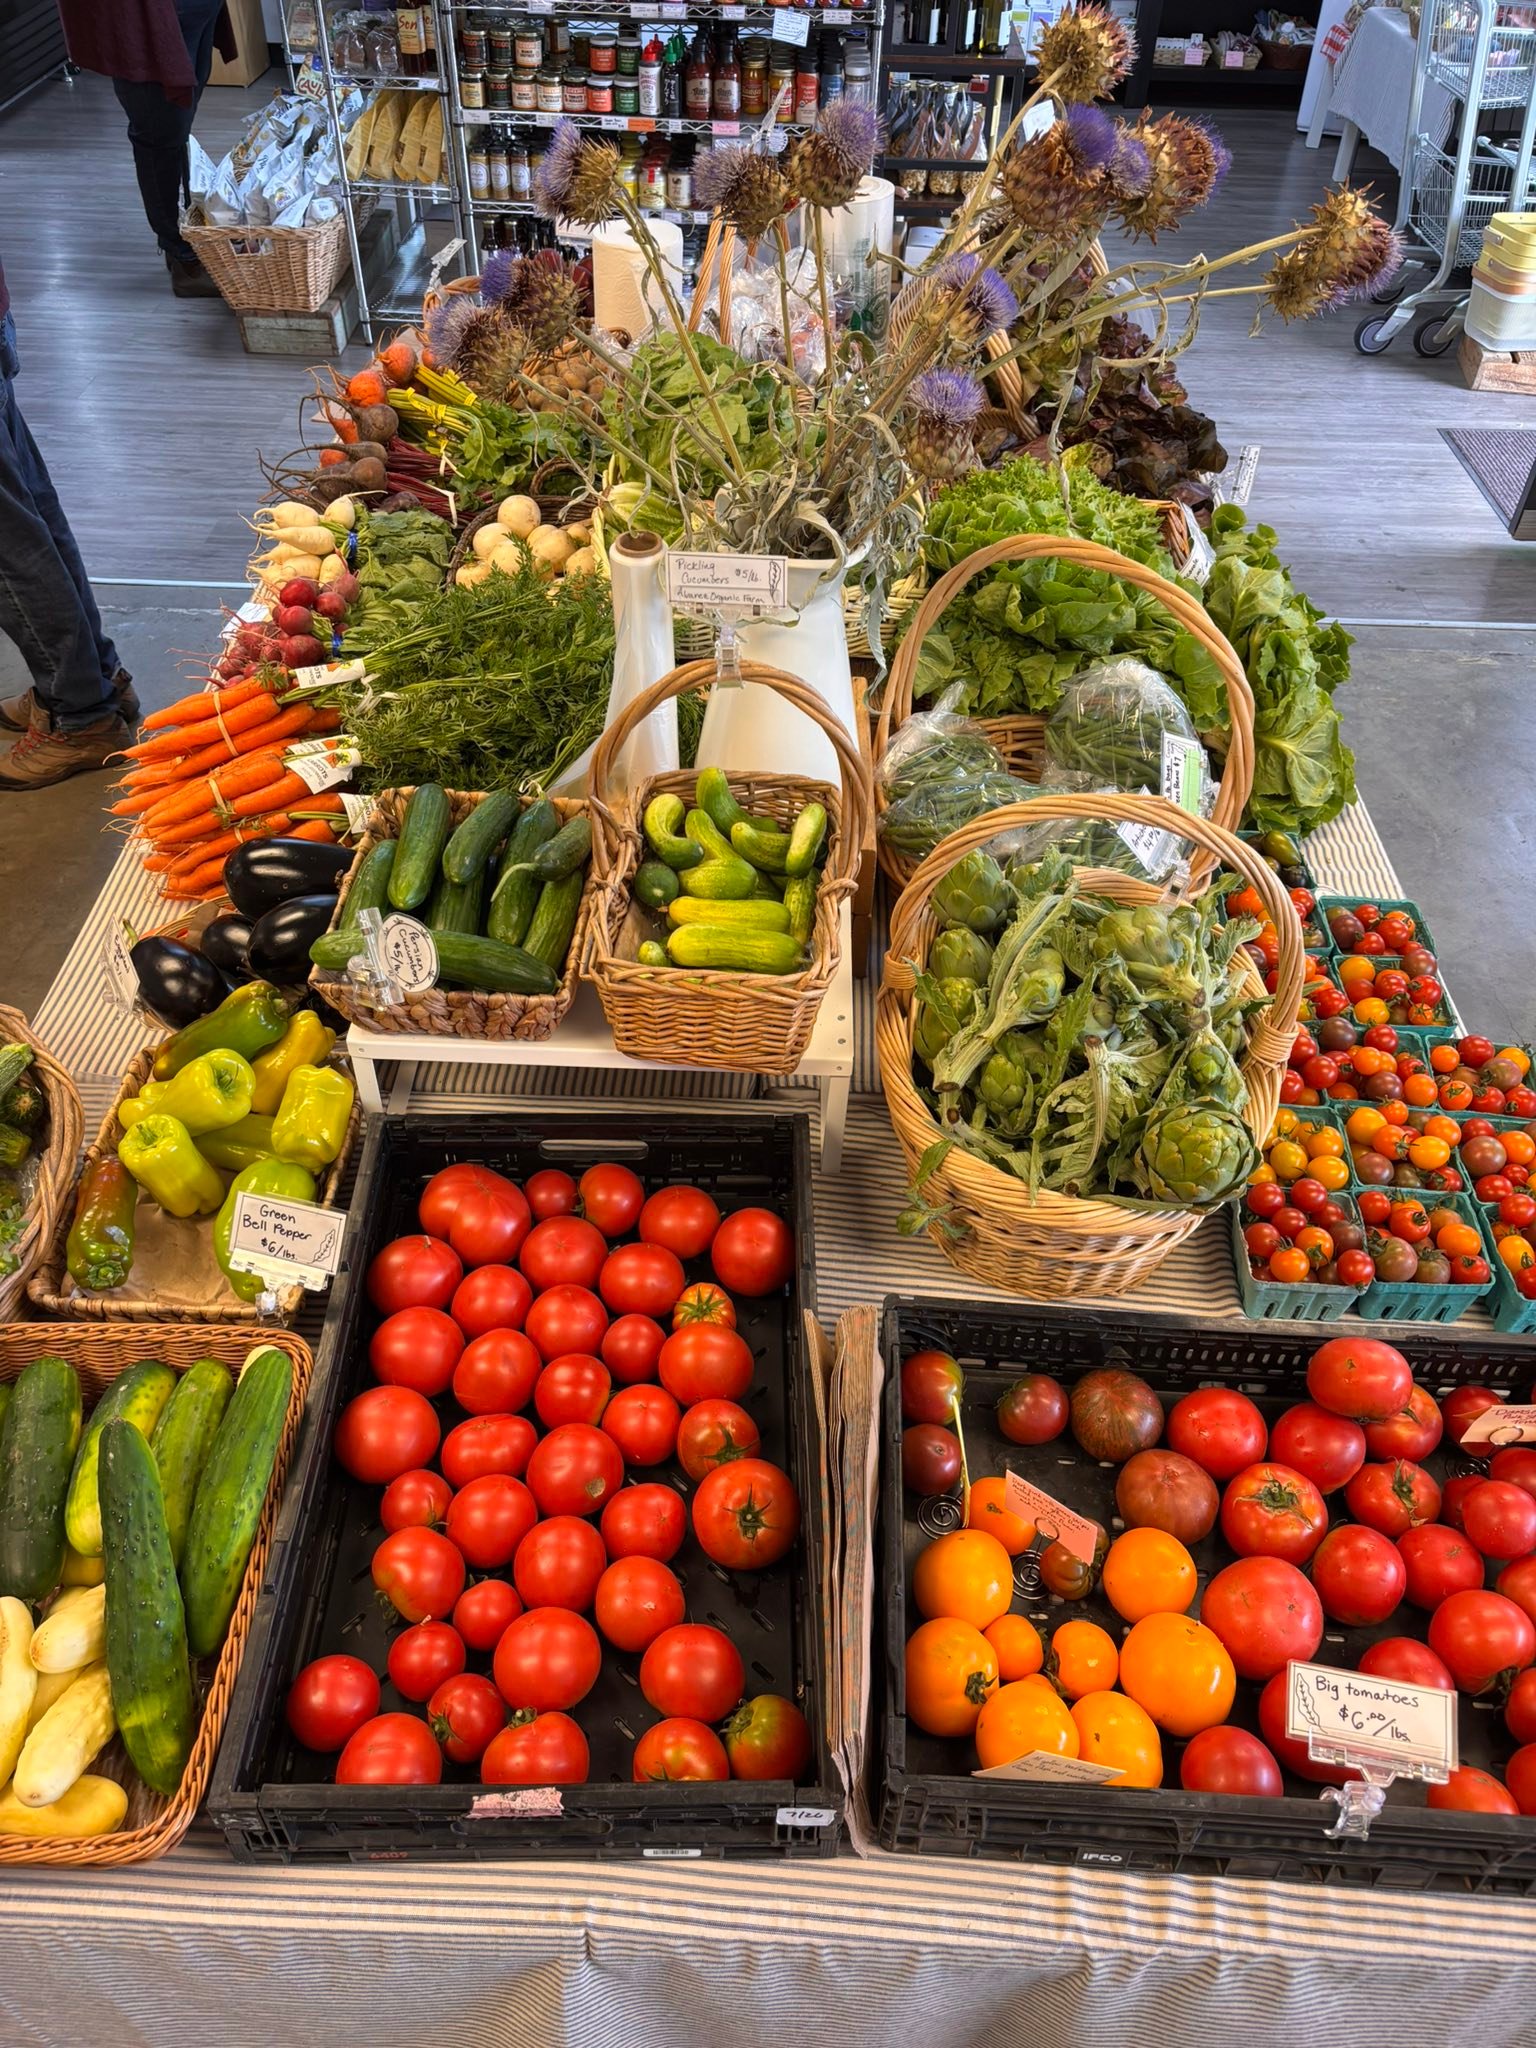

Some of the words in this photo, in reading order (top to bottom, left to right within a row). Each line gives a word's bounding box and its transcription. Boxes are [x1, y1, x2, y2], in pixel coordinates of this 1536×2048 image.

[675, 558, 715, 576] Pickling
[681, 572, 730, 585] Cucumbers
[399, 928, 420, 983] Cucumbers
[408, 931, 424, 971] Persian
[260, 1204, 296, 1224] Green
[243, 1214, 267, 1231] Bell
[273, 1223, 312, 1241] Pepper
[1315, 1675, 1340, 1701] Big
[1345, 1682, 1419, 1708] tomatoes
[1082, 1852, 1123, 1862] IFCO
